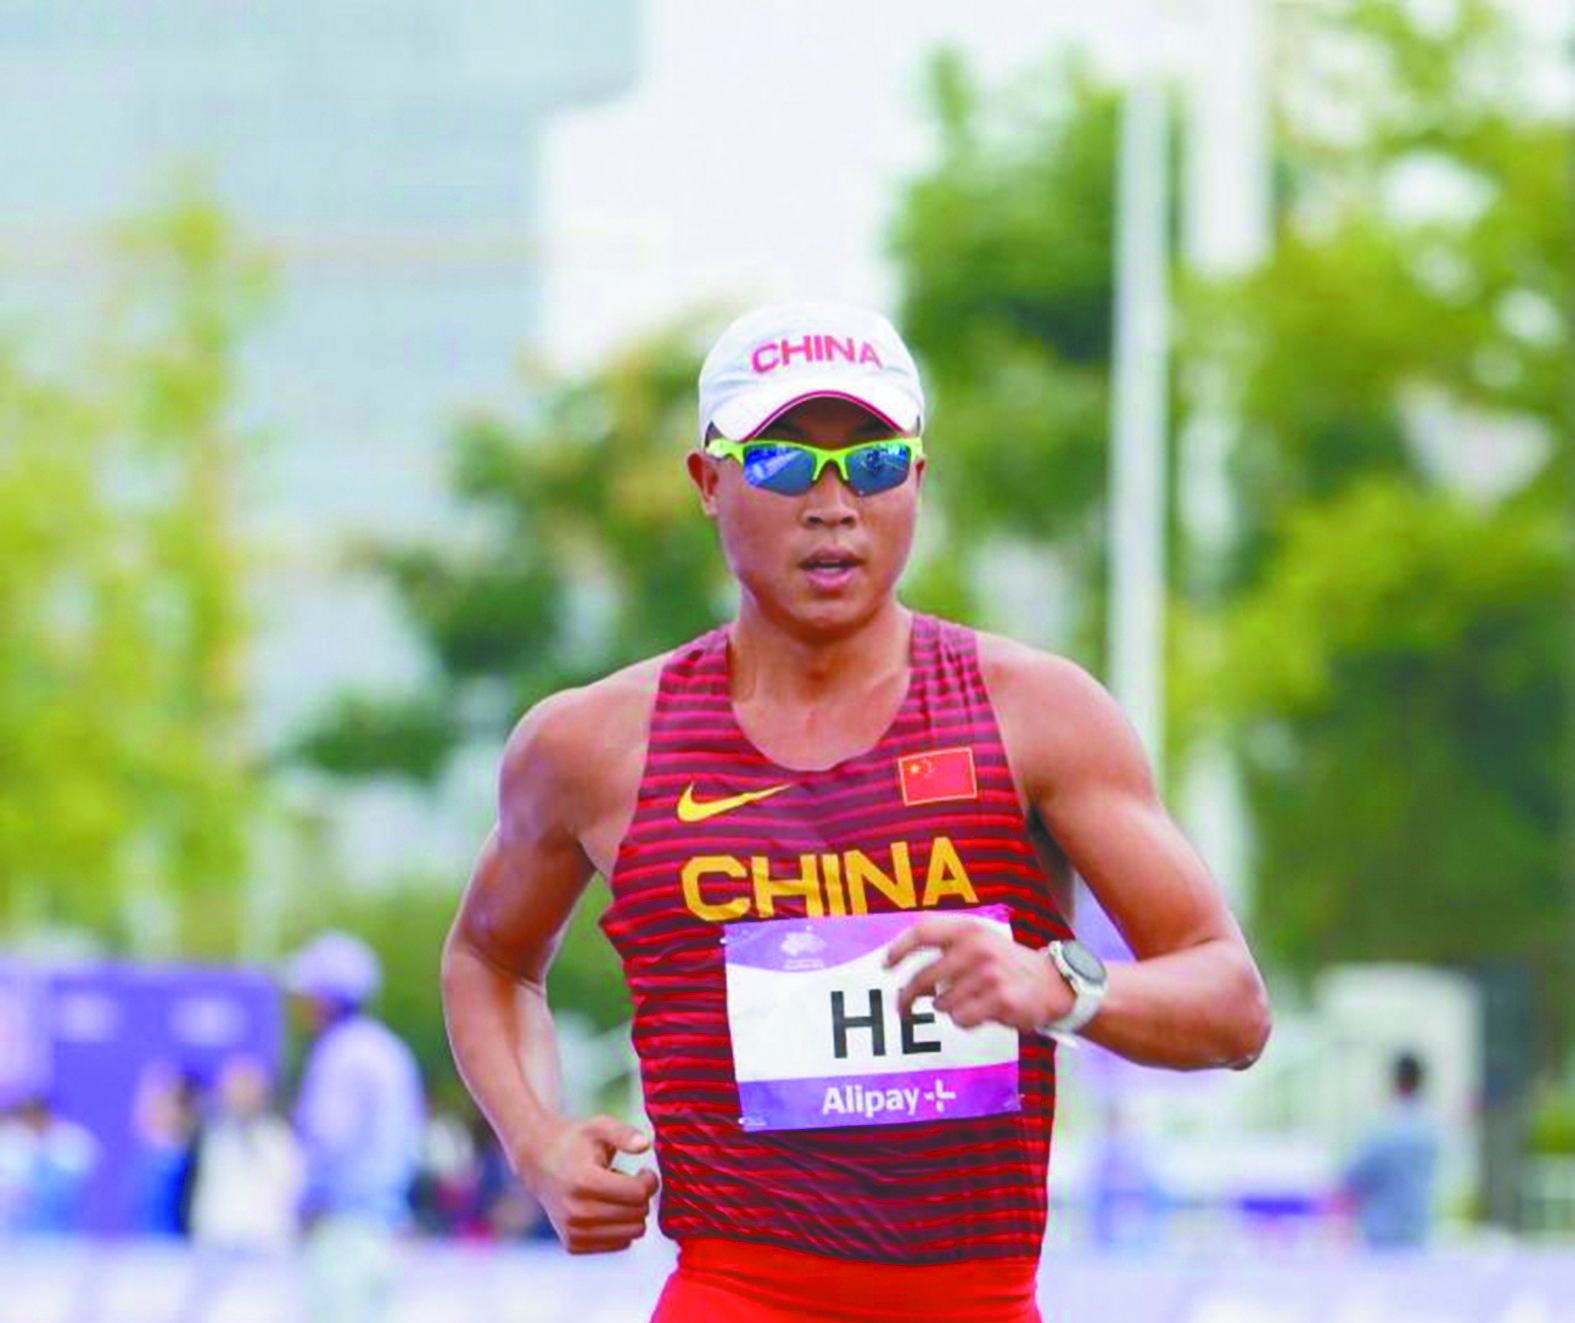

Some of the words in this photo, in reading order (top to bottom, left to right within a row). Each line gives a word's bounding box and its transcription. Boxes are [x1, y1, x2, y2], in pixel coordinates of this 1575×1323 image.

[752, 335, 883, 373] CHINA
[681, 837, 979, 921] CHINA
[830, 988, 942, 1058] HE
